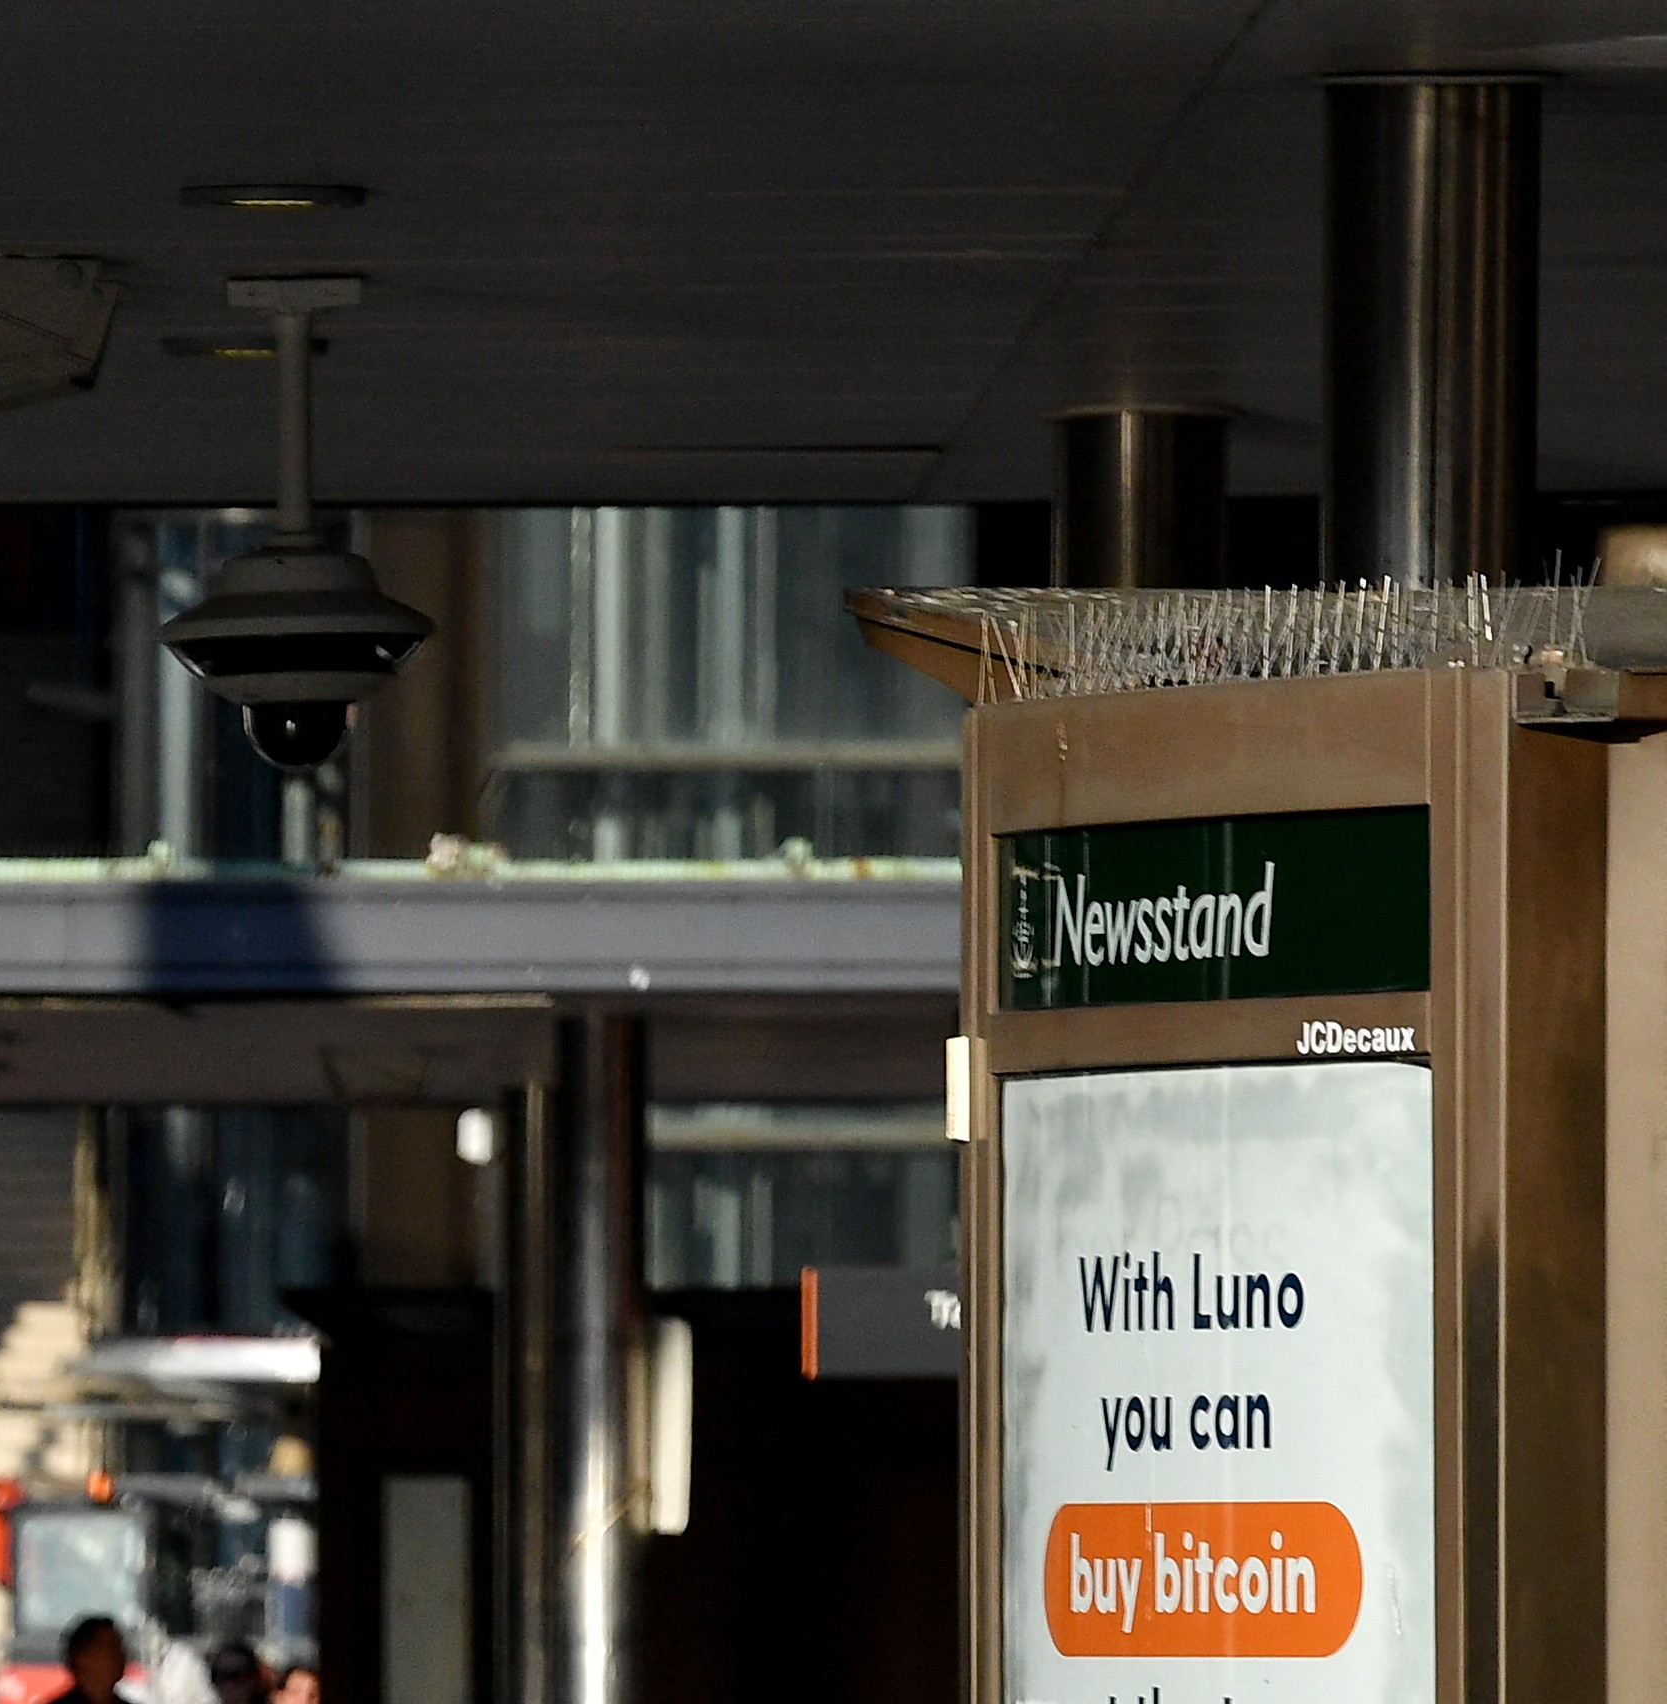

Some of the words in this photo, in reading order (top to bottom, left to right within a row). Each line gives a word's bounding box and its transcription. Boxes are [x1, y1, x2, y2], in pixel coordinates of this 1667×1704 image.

[1053, 861, 1276, 967] Newsstand
[1296, 1020, 1416, 1055] JCDecaux
[1079, 1250, 1175, 1333] With
[1193, 1253, 1304, 1330] Luno
[1101, 1396, 1172, 1472] you
[1189, 1394, 1271, 1450] can
[1070, 1532, 1142, 1634] buy
[1154, 1530, 1316, 1614] bitcoin
